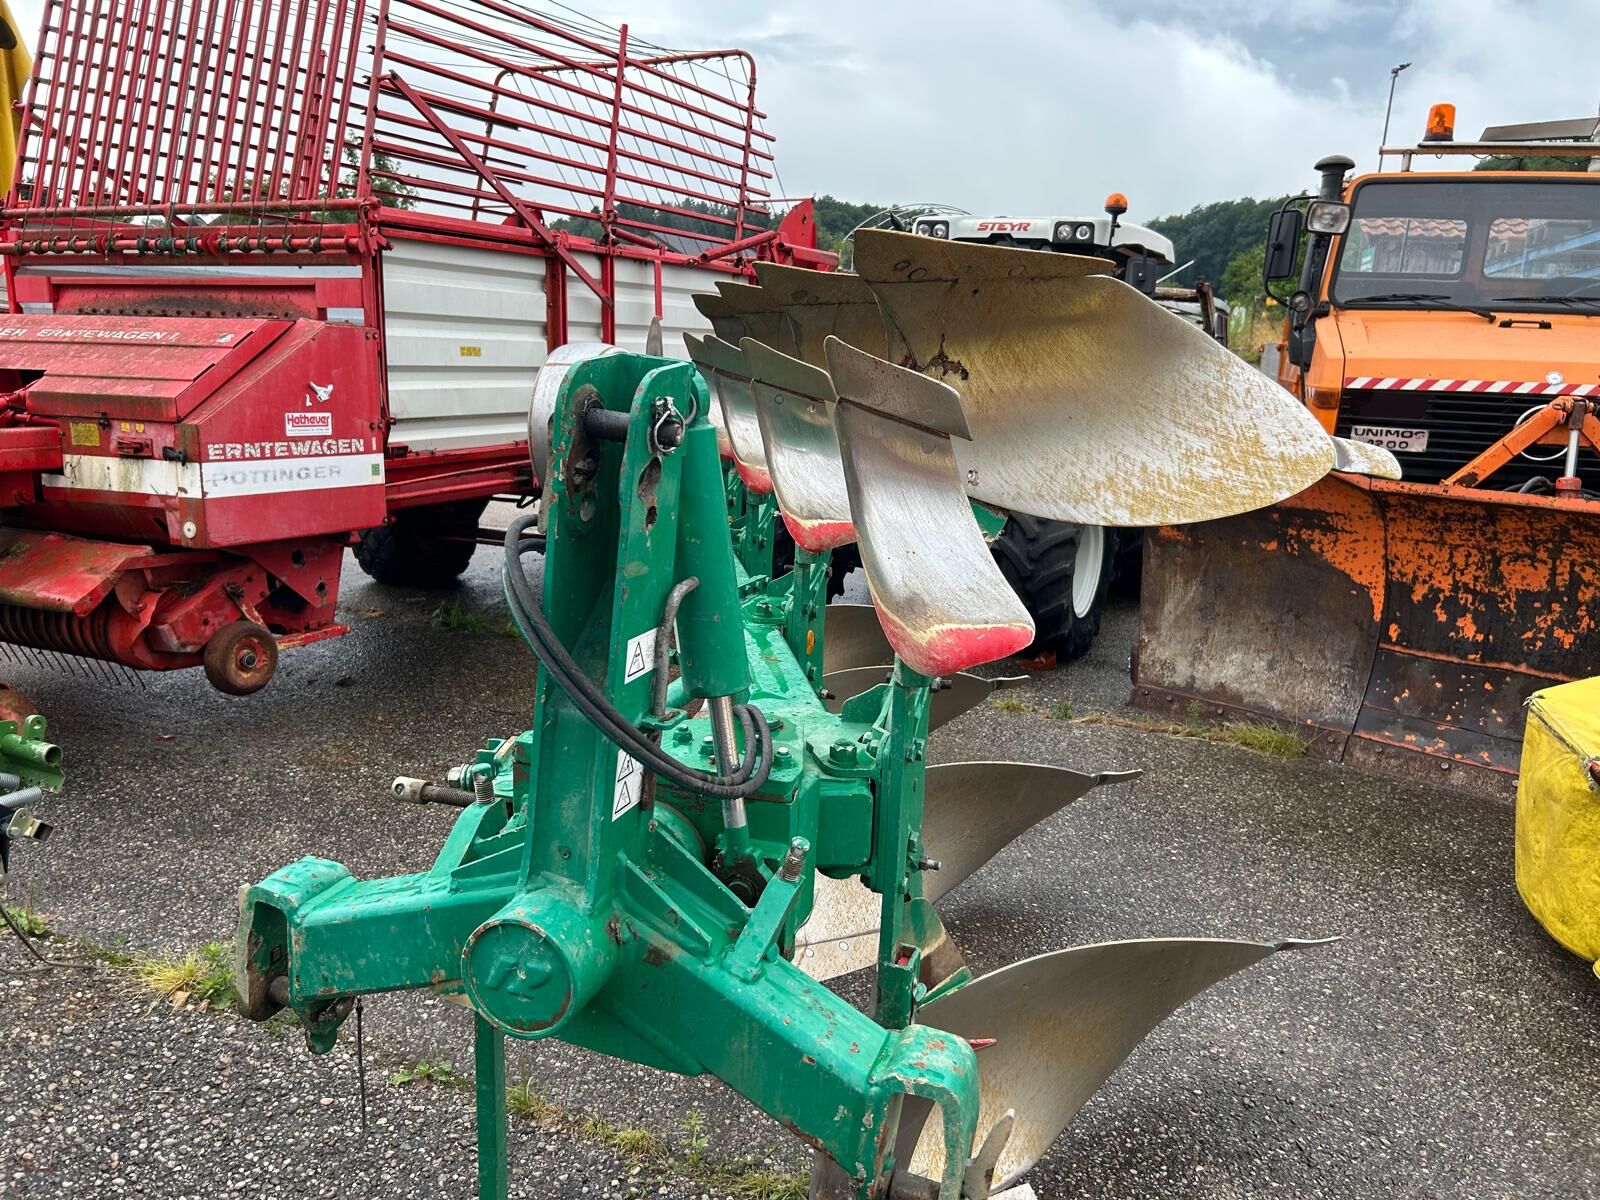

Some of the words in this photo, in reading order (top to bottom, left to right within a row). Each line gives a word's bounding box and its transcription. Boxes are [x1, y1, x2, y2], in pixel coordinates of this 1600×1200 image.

[977, 222, 1031, 232] STEYR
[37, 328, 167, 340] ERNTEWAGEN
[208, 439, 364, 460] ERNTEWAGEN
